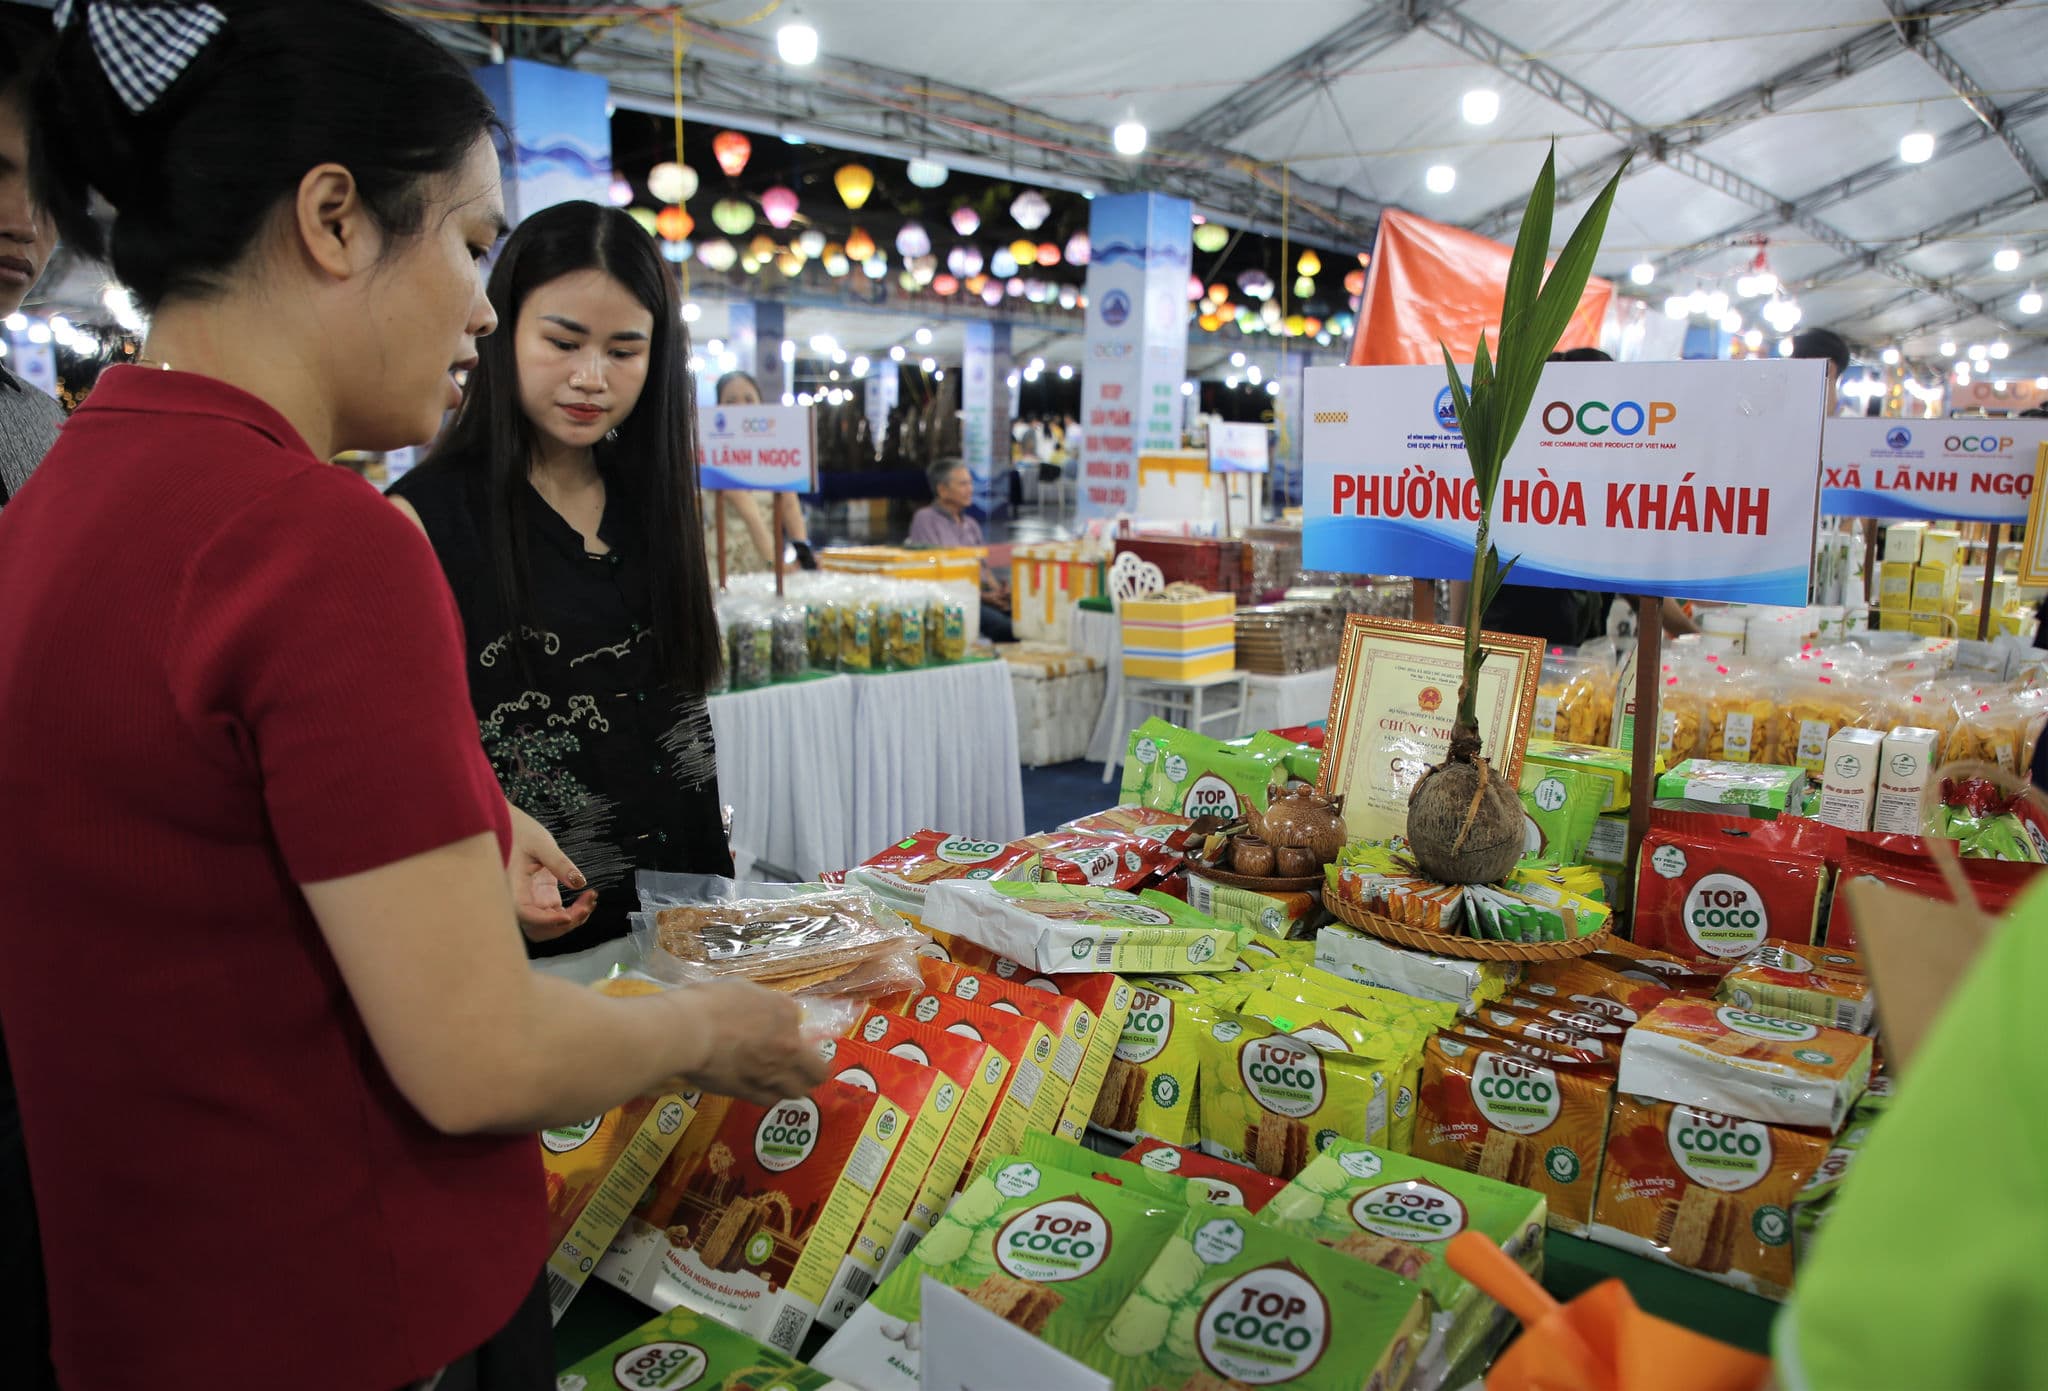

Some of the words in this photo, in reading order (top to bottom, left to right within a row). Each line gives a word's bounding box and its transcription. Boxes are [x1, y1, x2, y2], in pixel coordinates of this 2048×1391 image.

[1542, 401, 1677, 436] OCOP
[1945, 435, 2013, 453] OCOP
[1825, 464, 1861, 489] XÃ
[1970, 472, 2035, 500] NGỌ
[1333, 464, 1482, 522] PHƯỜNG
[1503, 468, 1587, 526] HÒA
[1606, 472, 1770, 536] KHÁNH
[1432, 727, 1452, 740] NH
[1196, 790, 1226, 805] TOP
[1189, 804, 1234, 819] COCO
[945, 842, 999, 853] COCO
[1700, 890, 1747, 908] TOP
[1691, 909, 1760, 928] COCO
[1131, 991, 1160, 1011] OP
[1726, 1011, 1808, 1031] COCO
[1538, 1025, 1588, 1046] TOP
[1258, 1043, 1306, 1066] TOP
[1249, 1063, 1315, 1089] COCO
[1488, 1056, 1540, 1079] TOP
[1478, 1077, 1552, 1103] COCO
[776, 1108, 811, 1127] TOP
[1489, 1102, 1516, 1111] COCONUT
[1518, 1106, 1545, 1114] CRACKER
[762, 1125, 811, 1146] COCO
[1677, 1127, 1762, 1156] COCO
[1384, 1191, 1445, 1210] TOP
[1034, 1214, 1092, 1236] TOP
[1364, 1203, 1452, 1226] COCO
[1009, 1231, 1095, 1259] COCO
[1013, 1264, 1057, 1278] Original
[1240, 1287, 1307, 1320] TOP
[1213, 1311, 1312, 1351] COCO
[625, 1348, 664, 1376] TOP
[637, 1349, 689, 1388] COCO
